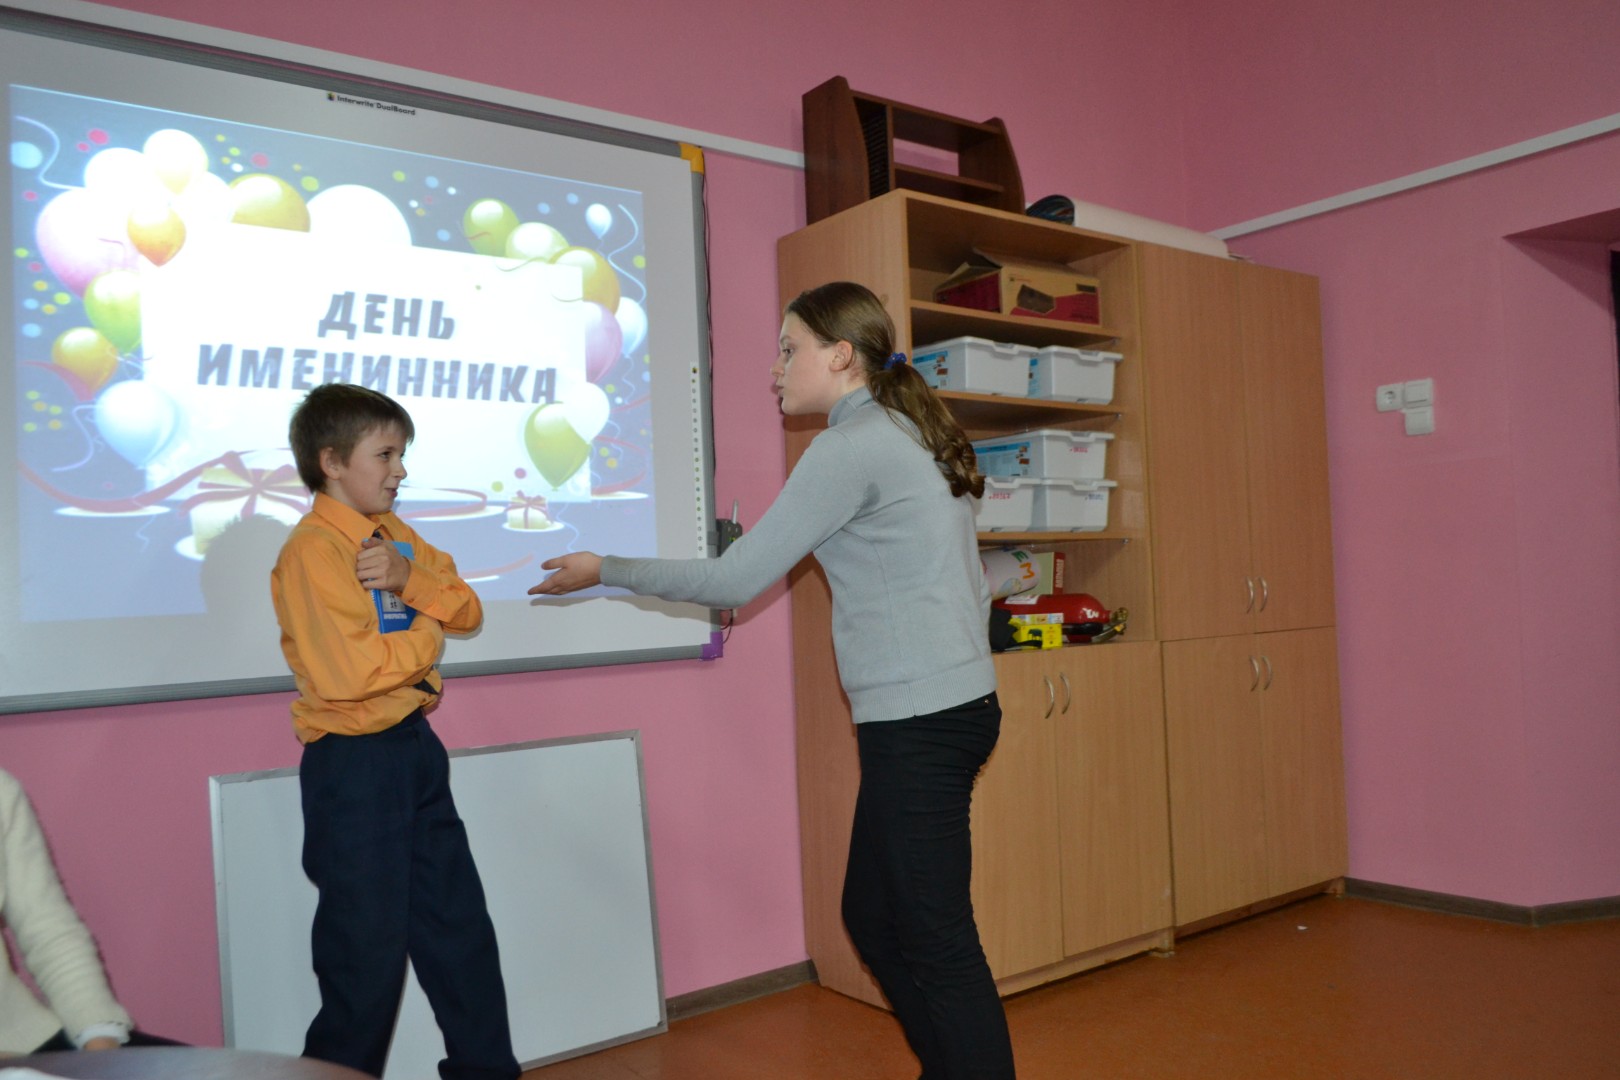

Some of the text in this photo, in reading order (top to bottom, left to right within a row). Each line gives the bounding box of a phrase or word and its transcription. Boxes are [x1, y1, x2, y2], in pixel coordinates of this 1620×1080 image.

[338, 96, 415, 115] Interwrite DualBoard
[318, 291, 456, 339] ДЕНЬ
[197, 344, 557, 404] ИМЕНИННИКА
